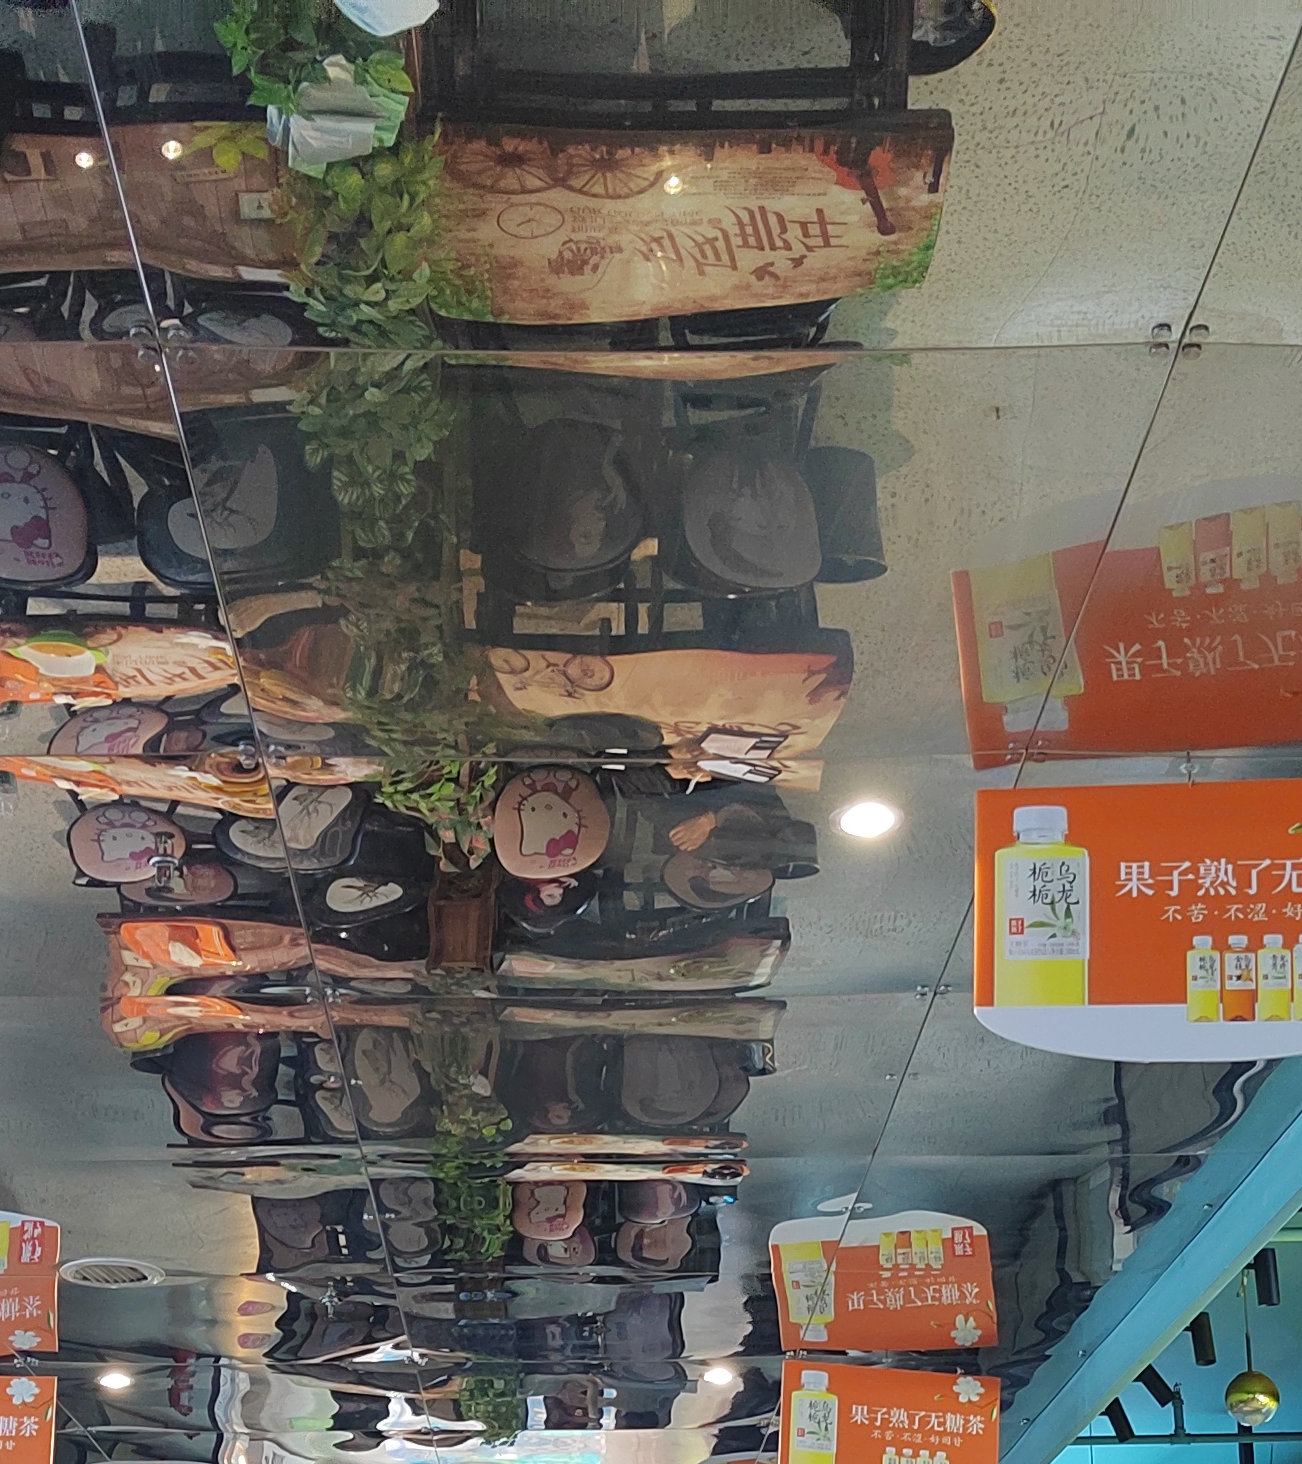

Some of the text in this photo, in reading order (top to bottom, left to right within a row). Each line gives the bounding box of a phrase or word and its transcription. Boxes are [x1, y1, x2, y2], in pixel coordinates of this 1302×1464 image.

[849, 1404, 985, 1435] 果子熟了无糖茶
